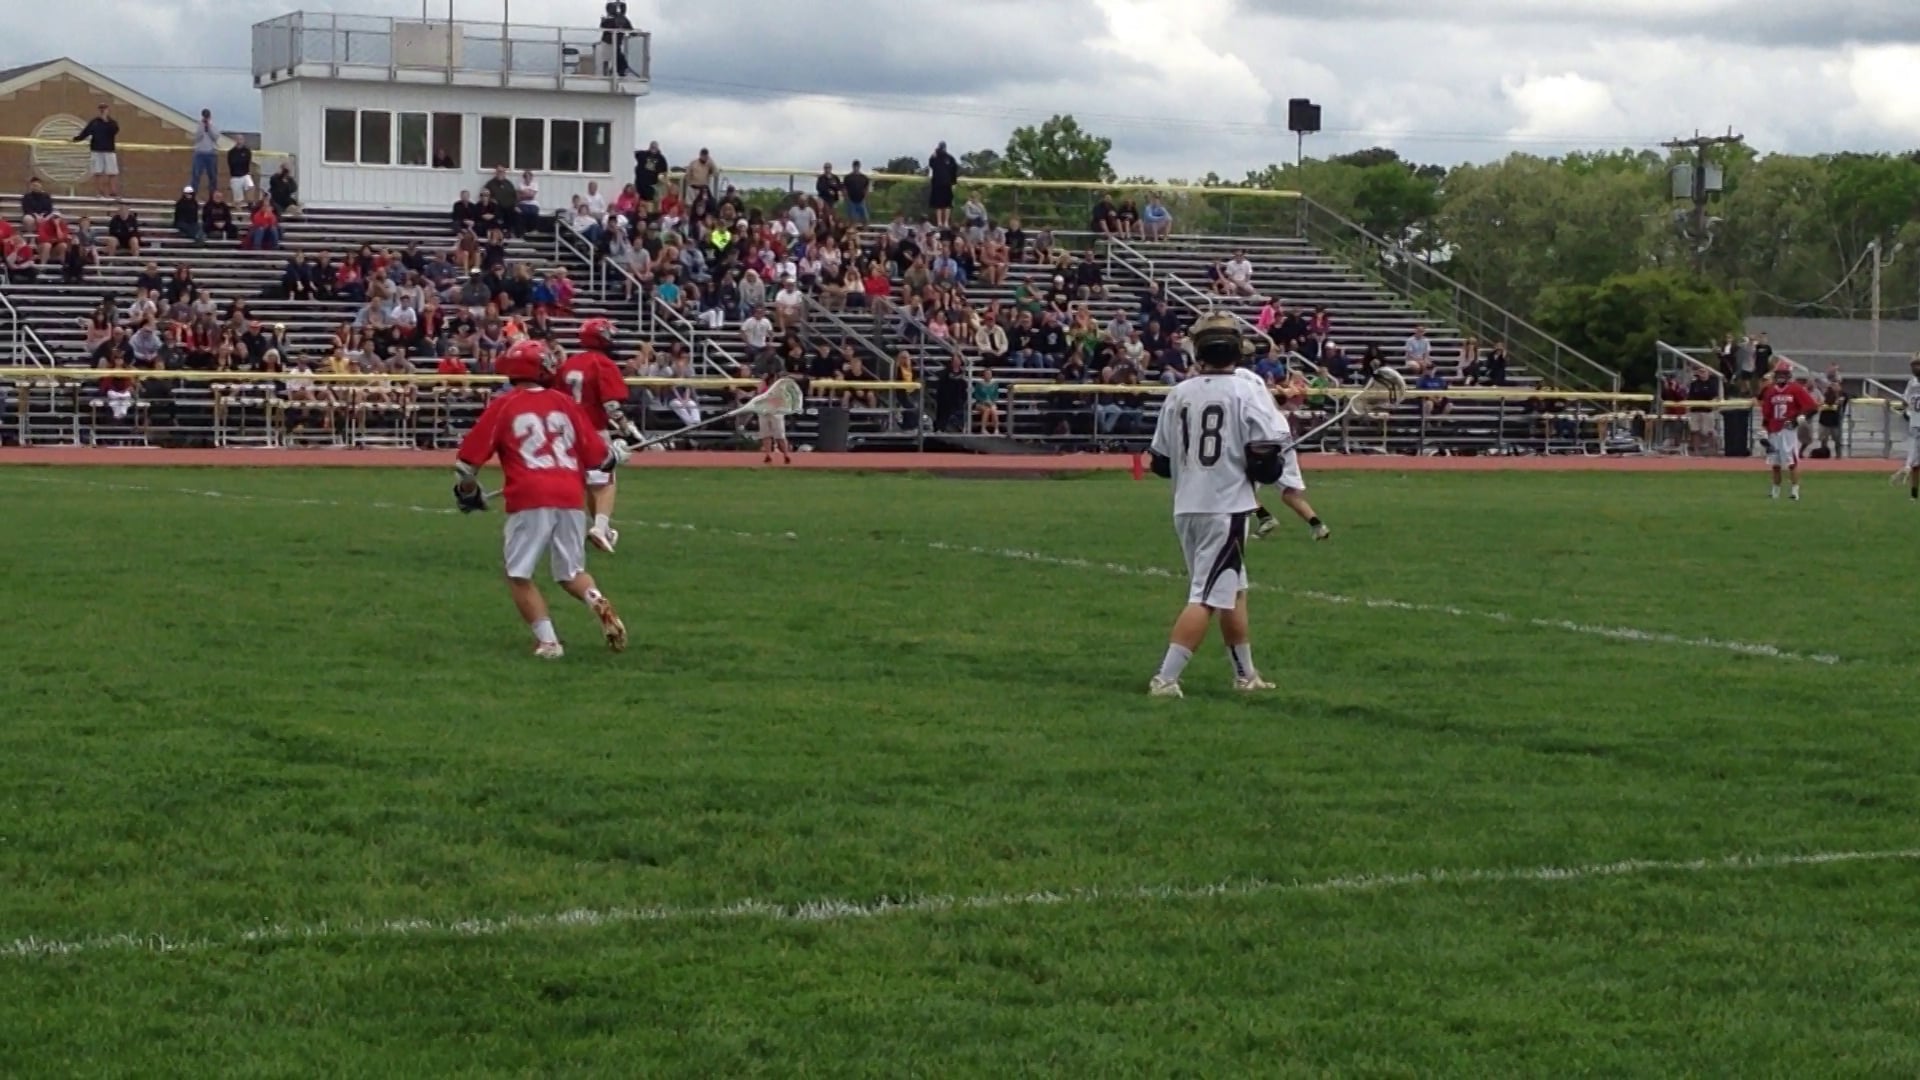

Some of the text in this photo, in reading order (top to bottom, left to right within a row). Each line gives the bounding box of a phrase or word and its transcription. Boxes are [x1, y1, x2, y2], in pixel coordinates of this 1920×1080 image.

[513, 411, 578, 470] 22
[1180, 403, 1224, 467] 18
[1774, 404, 1788, 419] 12
